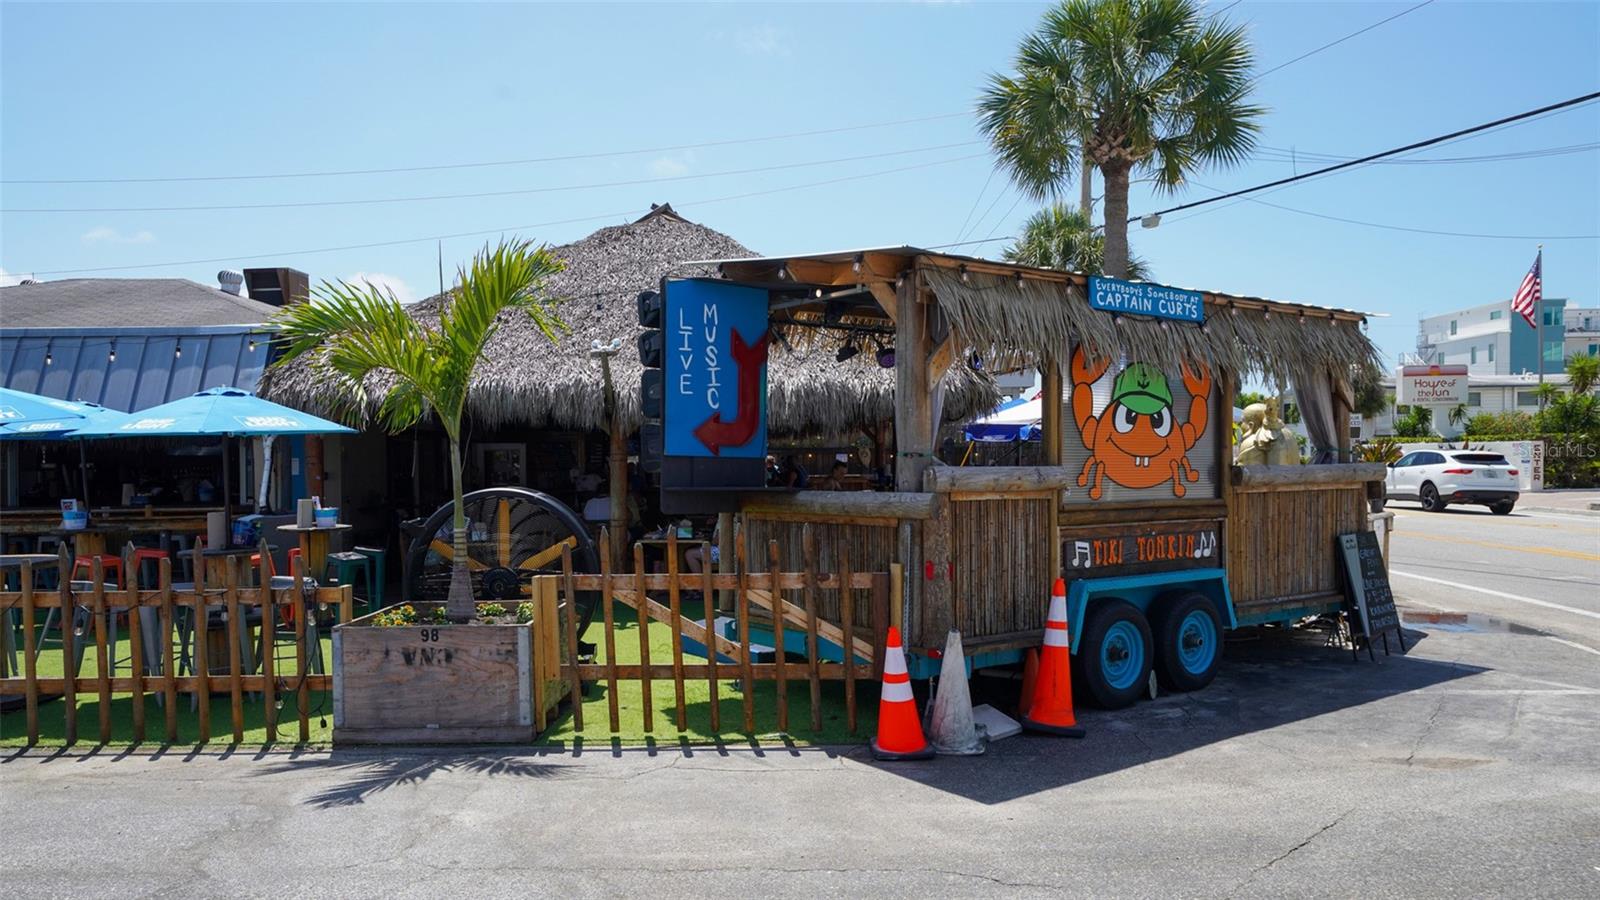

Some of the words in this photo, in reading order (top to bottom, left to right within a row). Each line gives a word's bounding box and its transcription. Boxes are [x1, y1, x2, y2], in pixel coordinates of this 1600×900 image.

[1096, 291, 1152, 312] CAPTAIN
[678, 307, 694, 394] LIVE
[703, 302, 721, 409] MUSIC
[1093, 539, 1122, 565] TIKI
[1137, 534, 1195, 561] TONKIN
[421, 629, 439, 642] 98
